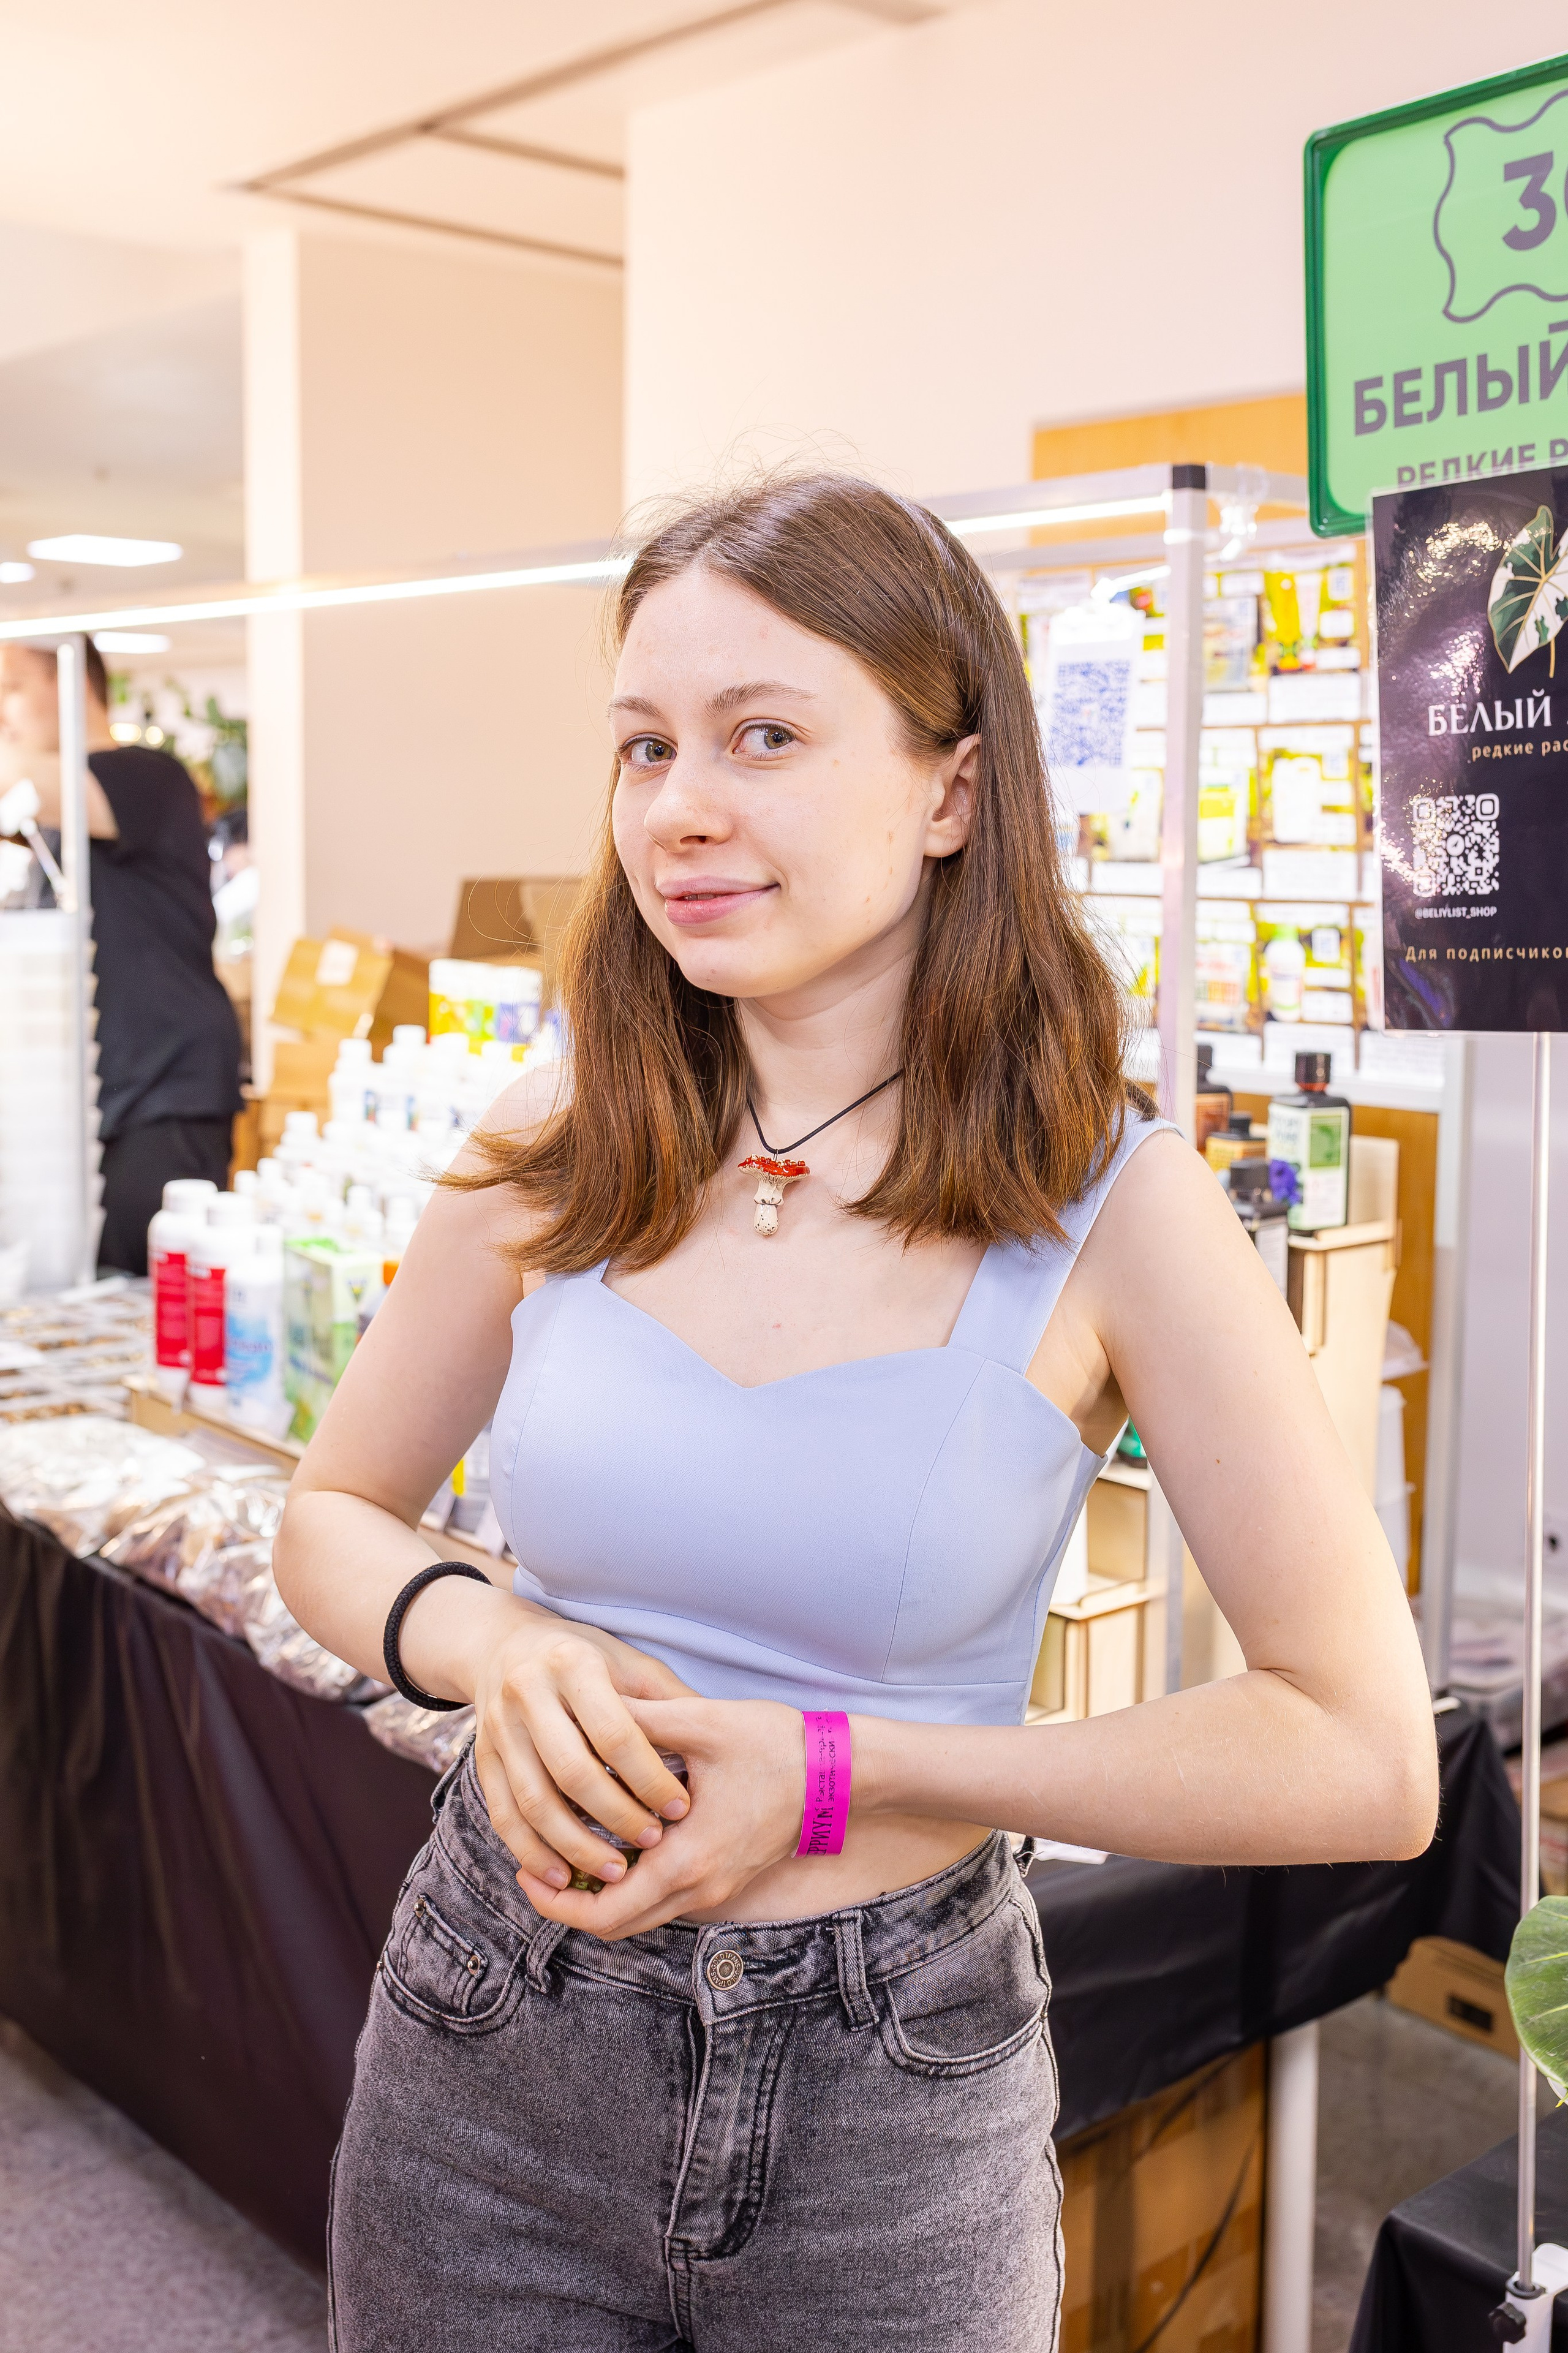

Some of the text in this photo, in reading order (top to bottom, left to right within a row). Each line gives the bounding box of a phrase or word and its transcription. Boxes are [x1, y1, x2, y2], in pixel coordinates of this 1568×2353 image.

[1502, 151, 1568, 251] 3
[1354, 319, 1568, 437] БЕЛЫЙ
[1428, 688, 1552, 736] БЕЛЫЙ
[1471, 742, 1534, 762] редкие
[1406, 946, 1437, 962] Для
